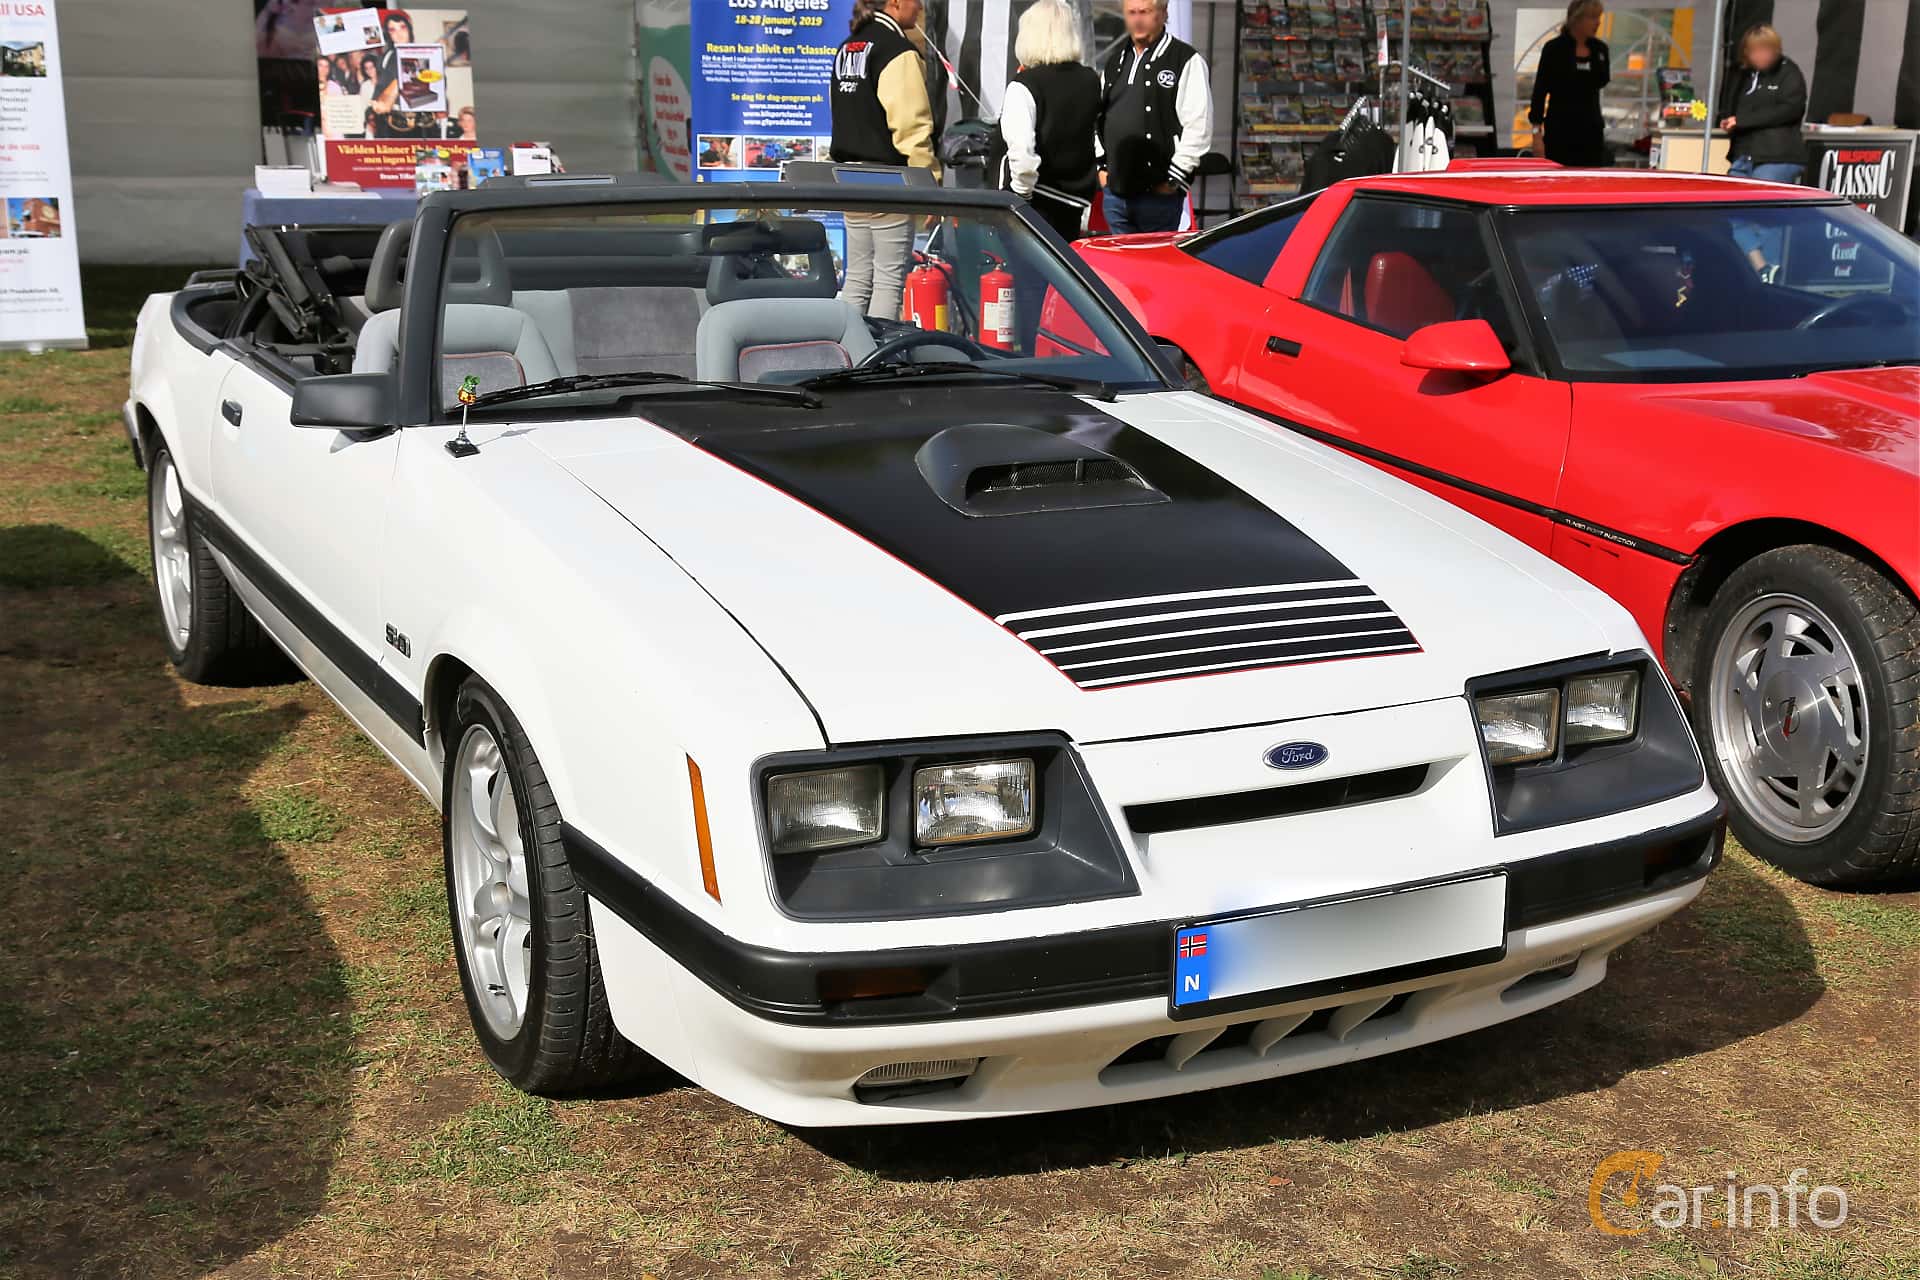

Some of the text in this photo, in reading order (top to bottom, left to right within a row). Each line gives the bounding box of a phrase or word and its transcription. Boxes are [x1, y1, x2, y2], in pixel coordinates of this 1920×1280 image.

[15, 4, 46, 16] USA
[760, 0, 829, 13] Angeles
[761, 15, 797, 26] januari,
[799, 16, 823, 26] 2019
[706, 43, 736, 54] Resan
[737, 43, 754, 54] har
[755, 44, 780, 54] blivit
[782, 46, 796, 55] en
[337, 143, 376, 155] Världen
[376, 143, 409, 155] känner
[1819, 149, 1897, 199] CLASSIC
[1281, 746, 1315, 764] Ford
[1184, 973, 1200, 993] N
